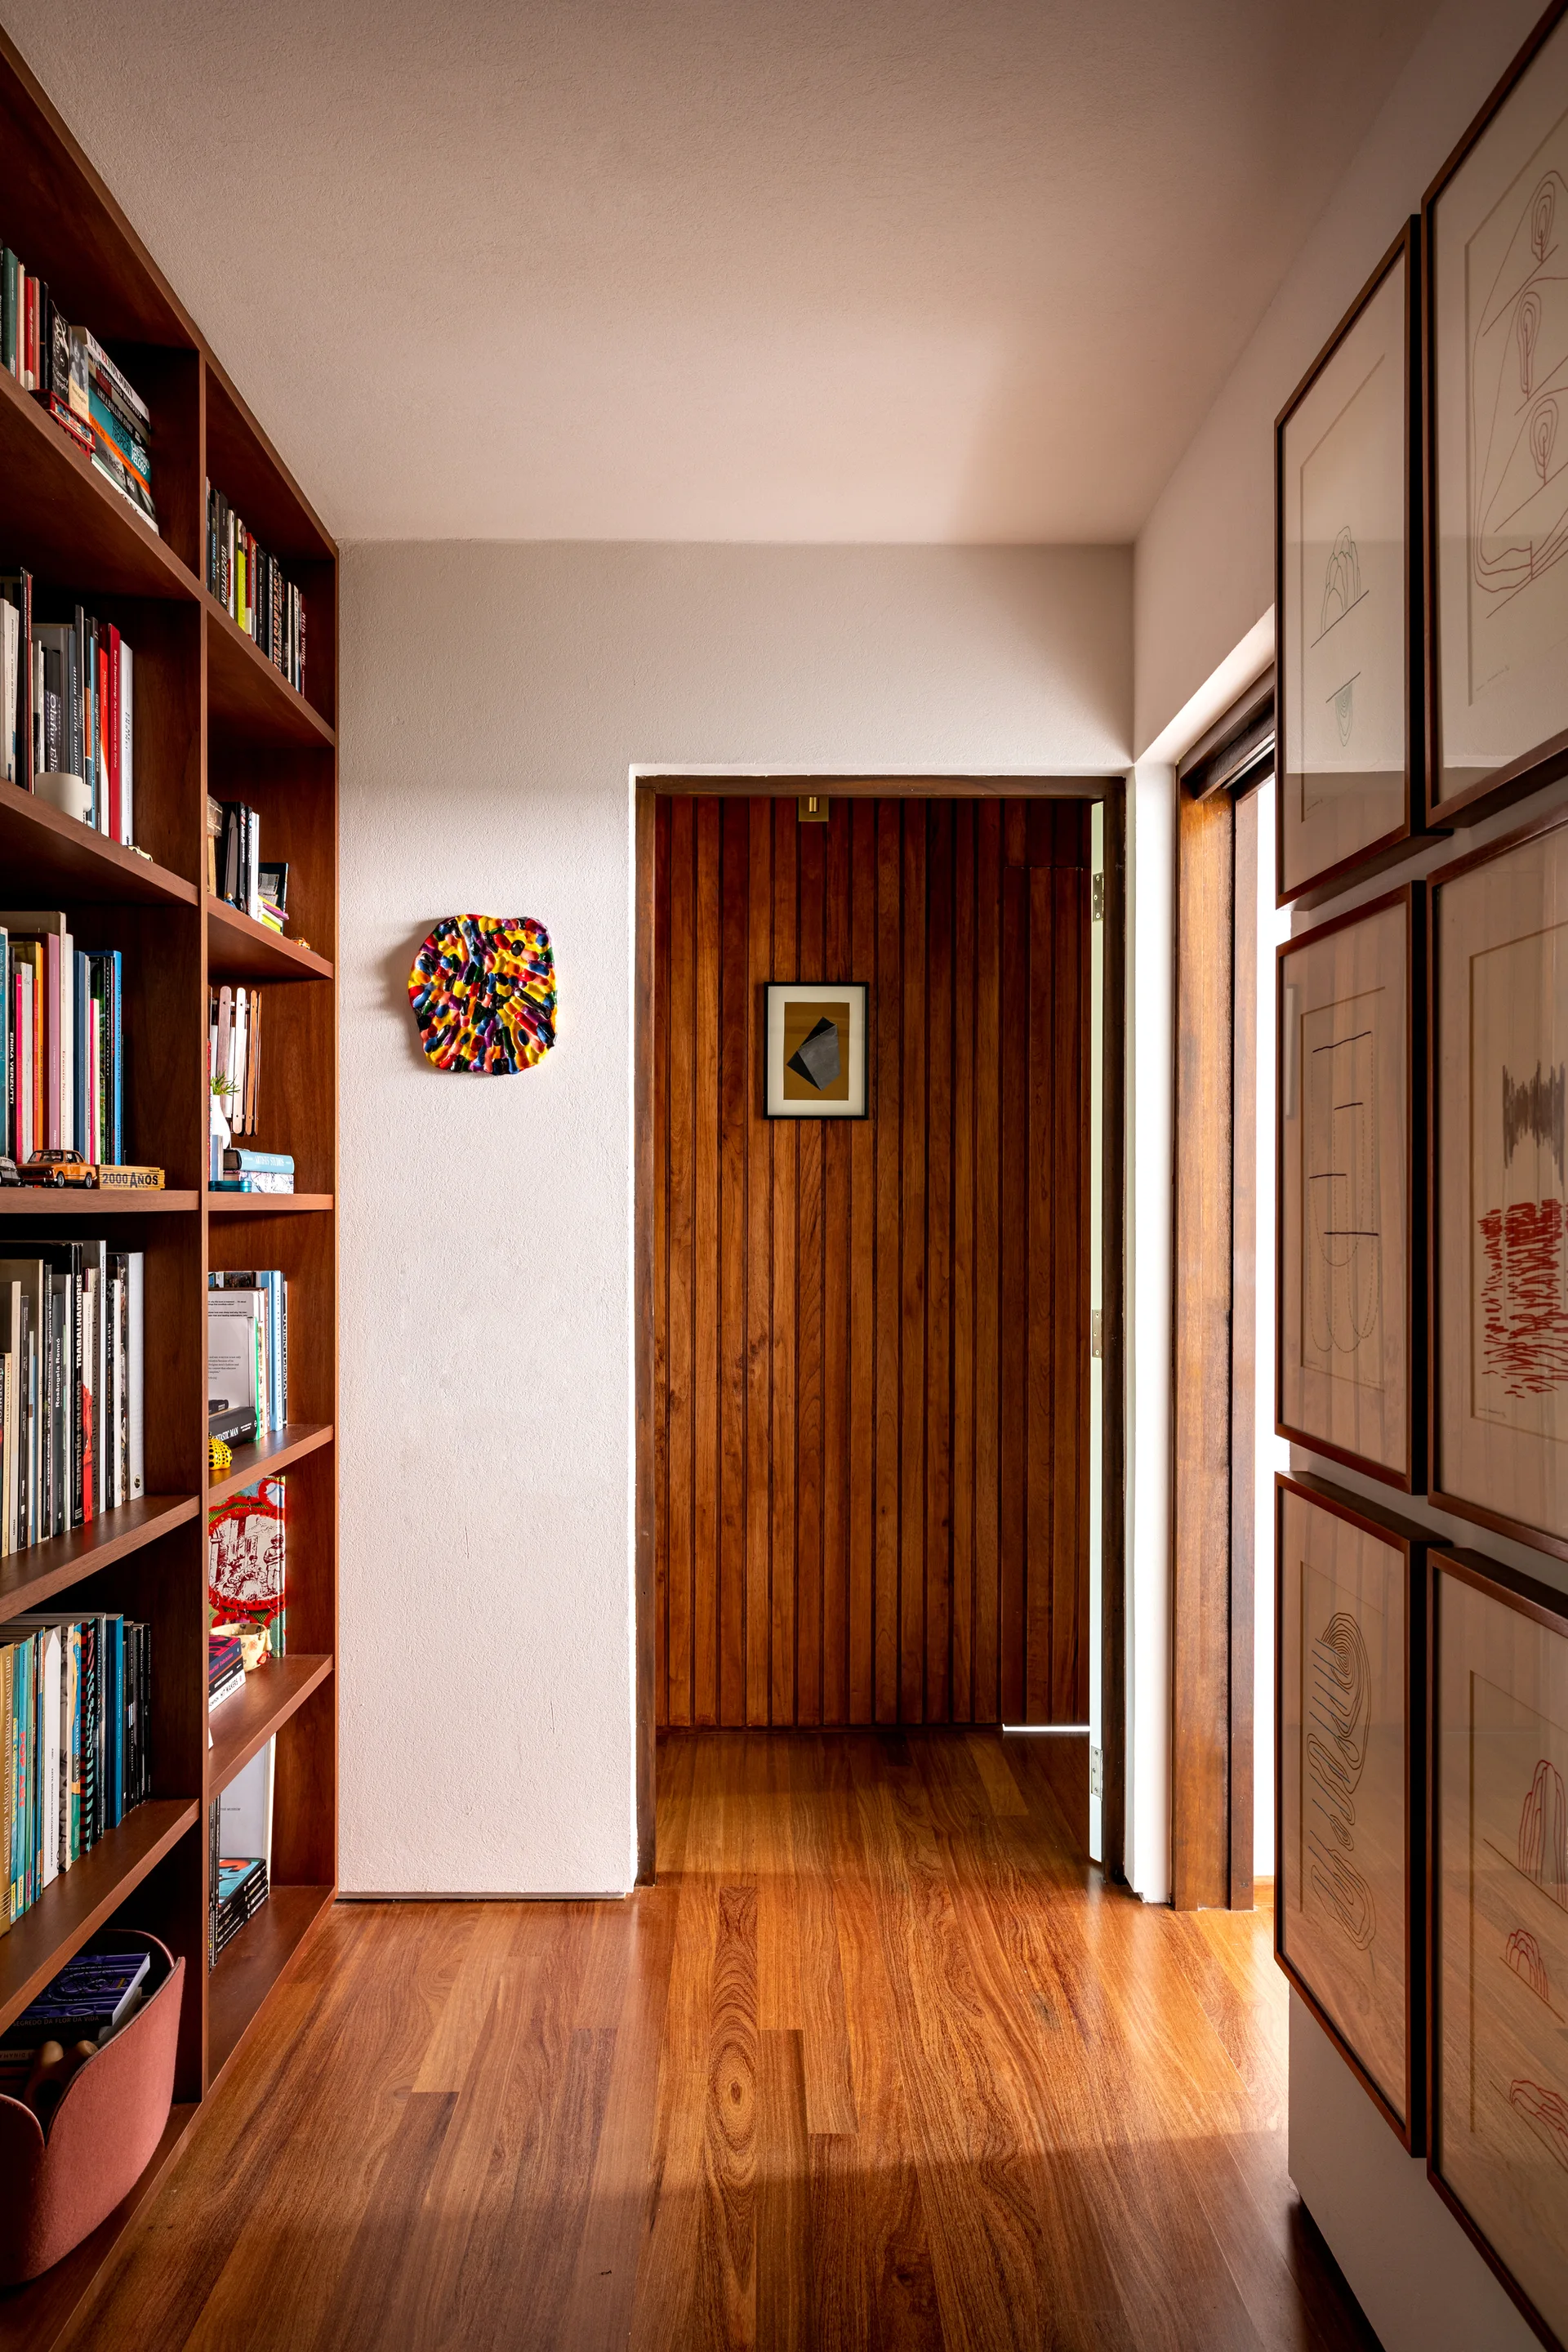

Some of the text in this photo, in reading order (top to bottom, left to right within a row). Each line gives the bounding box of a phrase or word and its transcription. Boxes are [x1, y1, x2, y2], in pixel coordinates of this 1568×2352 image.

[102, 1173, 128, 1184] 2000
[4, 1760, 10, 1774] DO
[12, 2015, 100, 2027] SEGREDO DA FLOR DA VIDA
